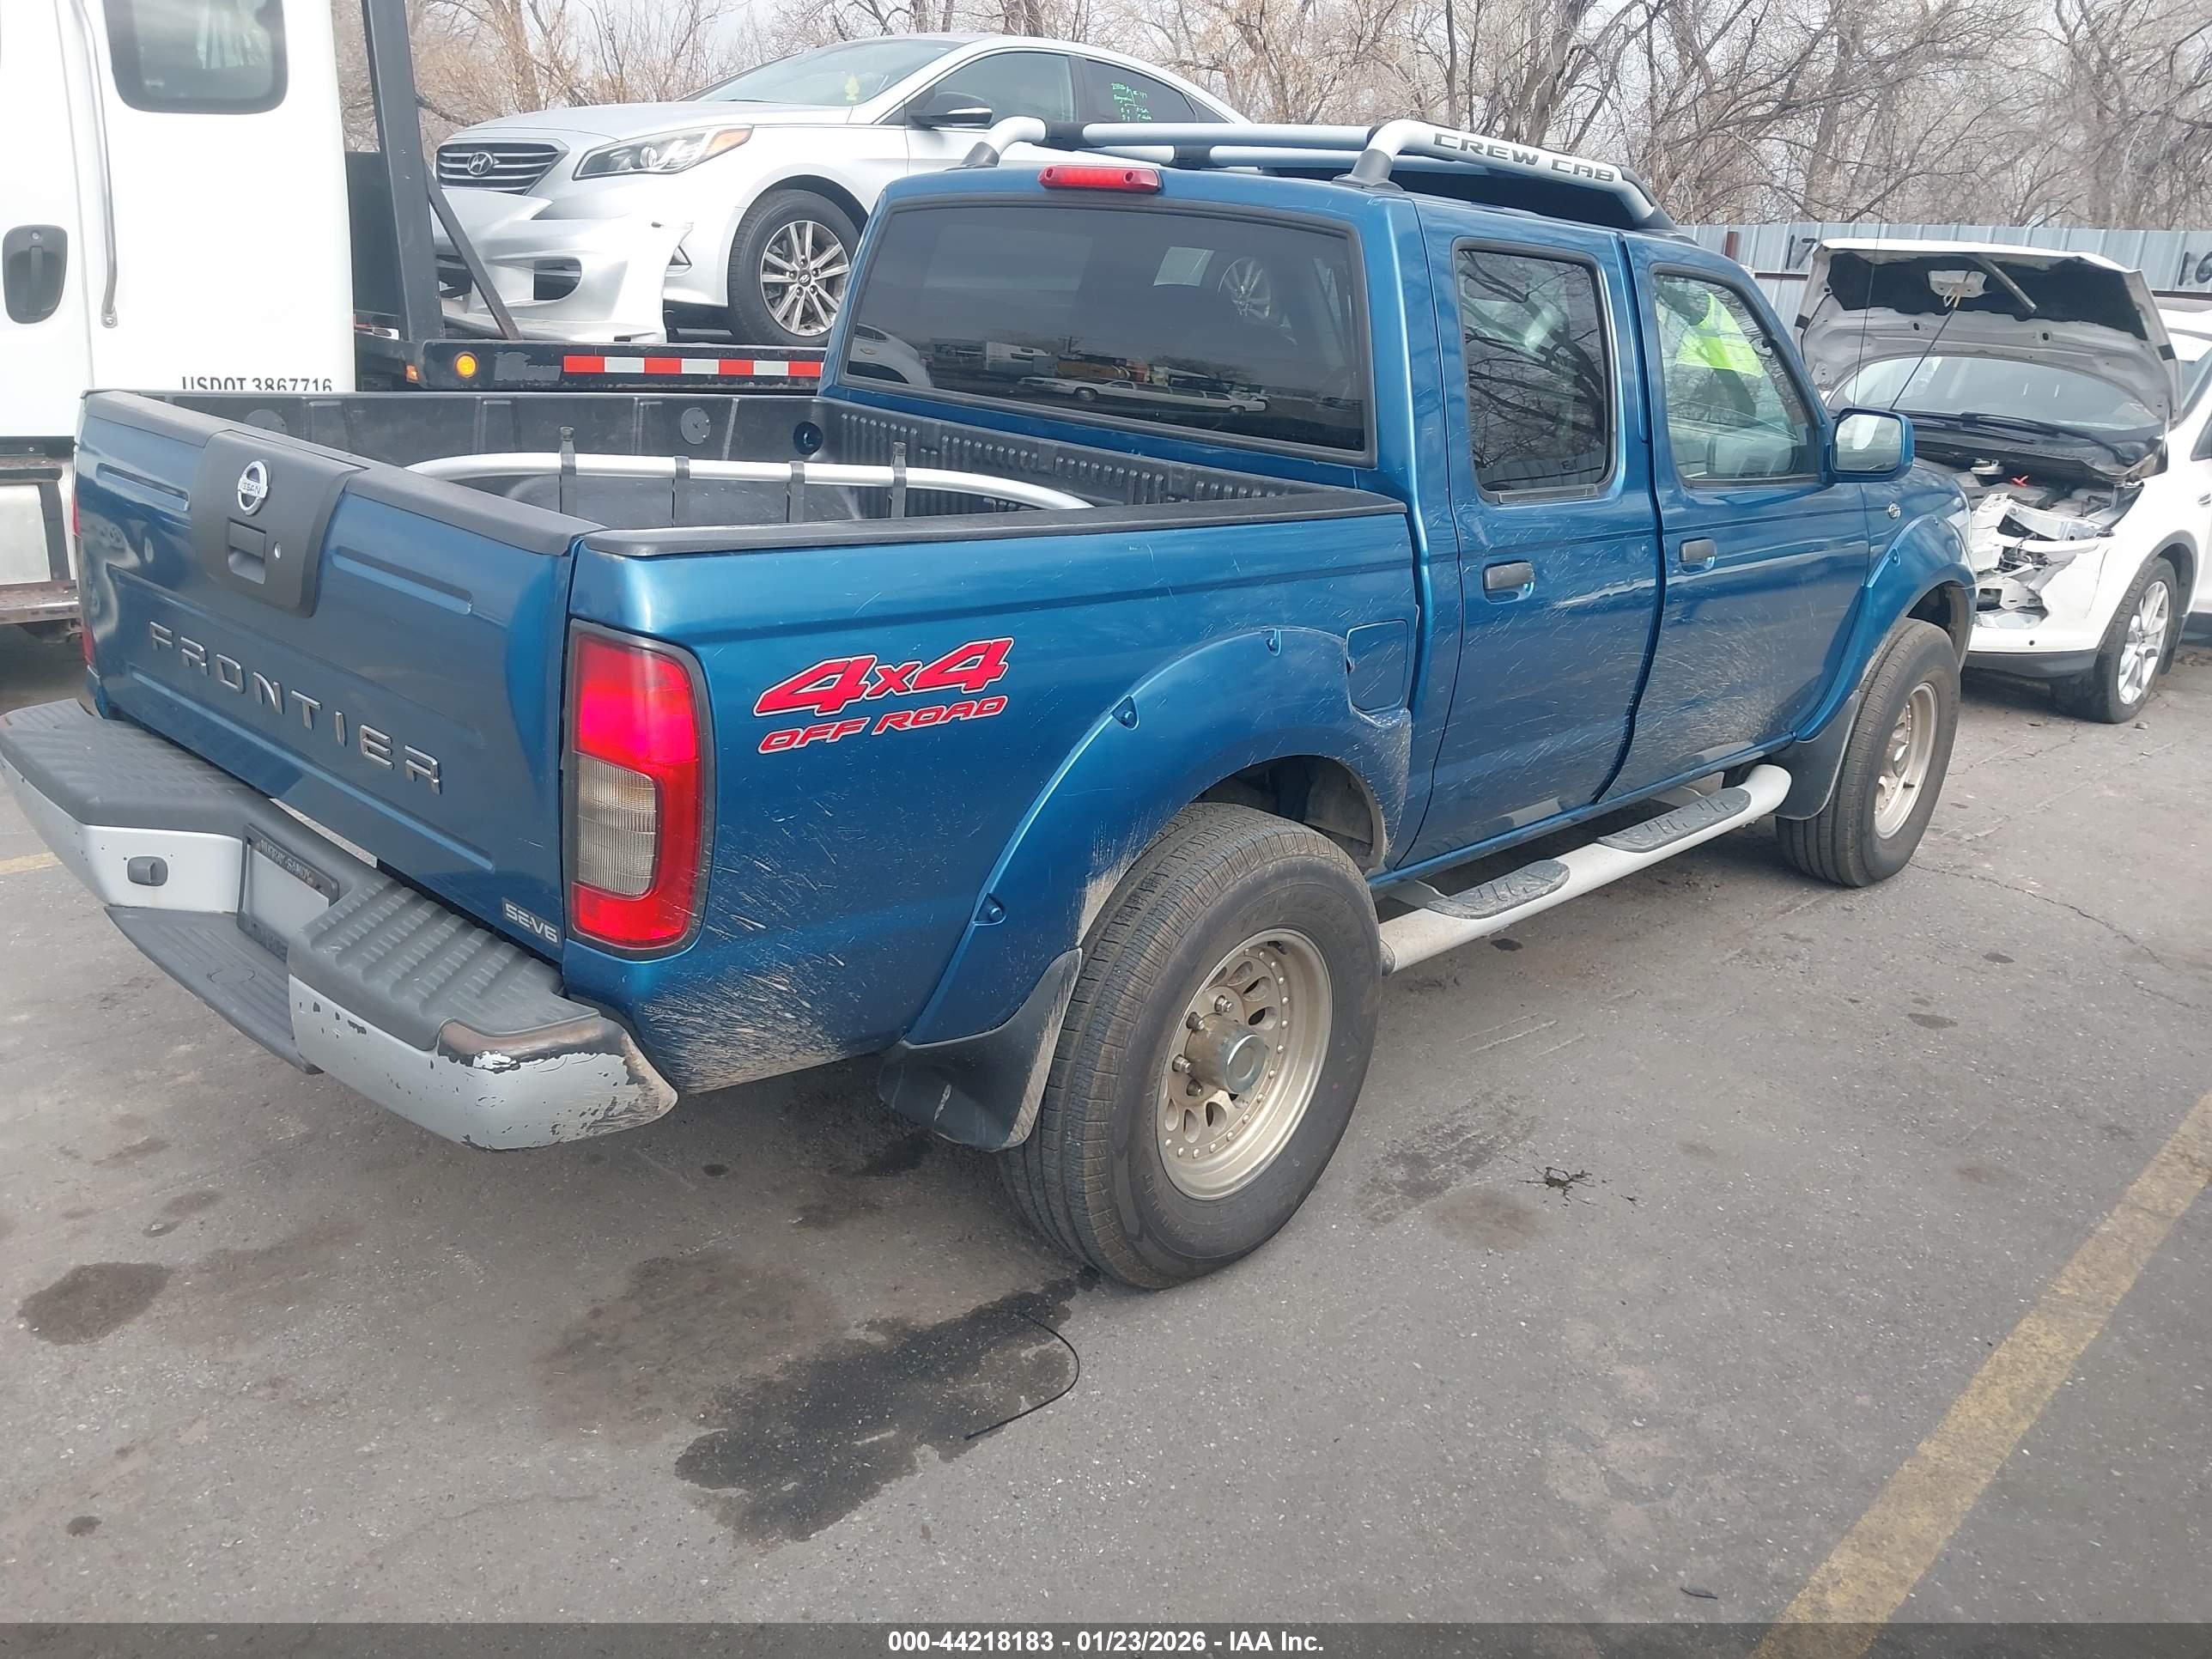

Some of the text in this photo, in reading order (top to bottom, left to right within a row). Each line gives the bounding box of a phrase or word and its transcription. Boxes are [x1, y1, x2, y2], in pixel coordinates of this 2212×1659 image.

[1434, 133, 1615, 182] CREW CAB
[1785, 234, 1817, 270] 17
[182, 376, 333, 392] USDOT 3867716
[753, 636, 1014, 716] 4x4
[149, 621, 441, 795] FRONTIER
[758, 696, 1008, 754] OFF ROAD
